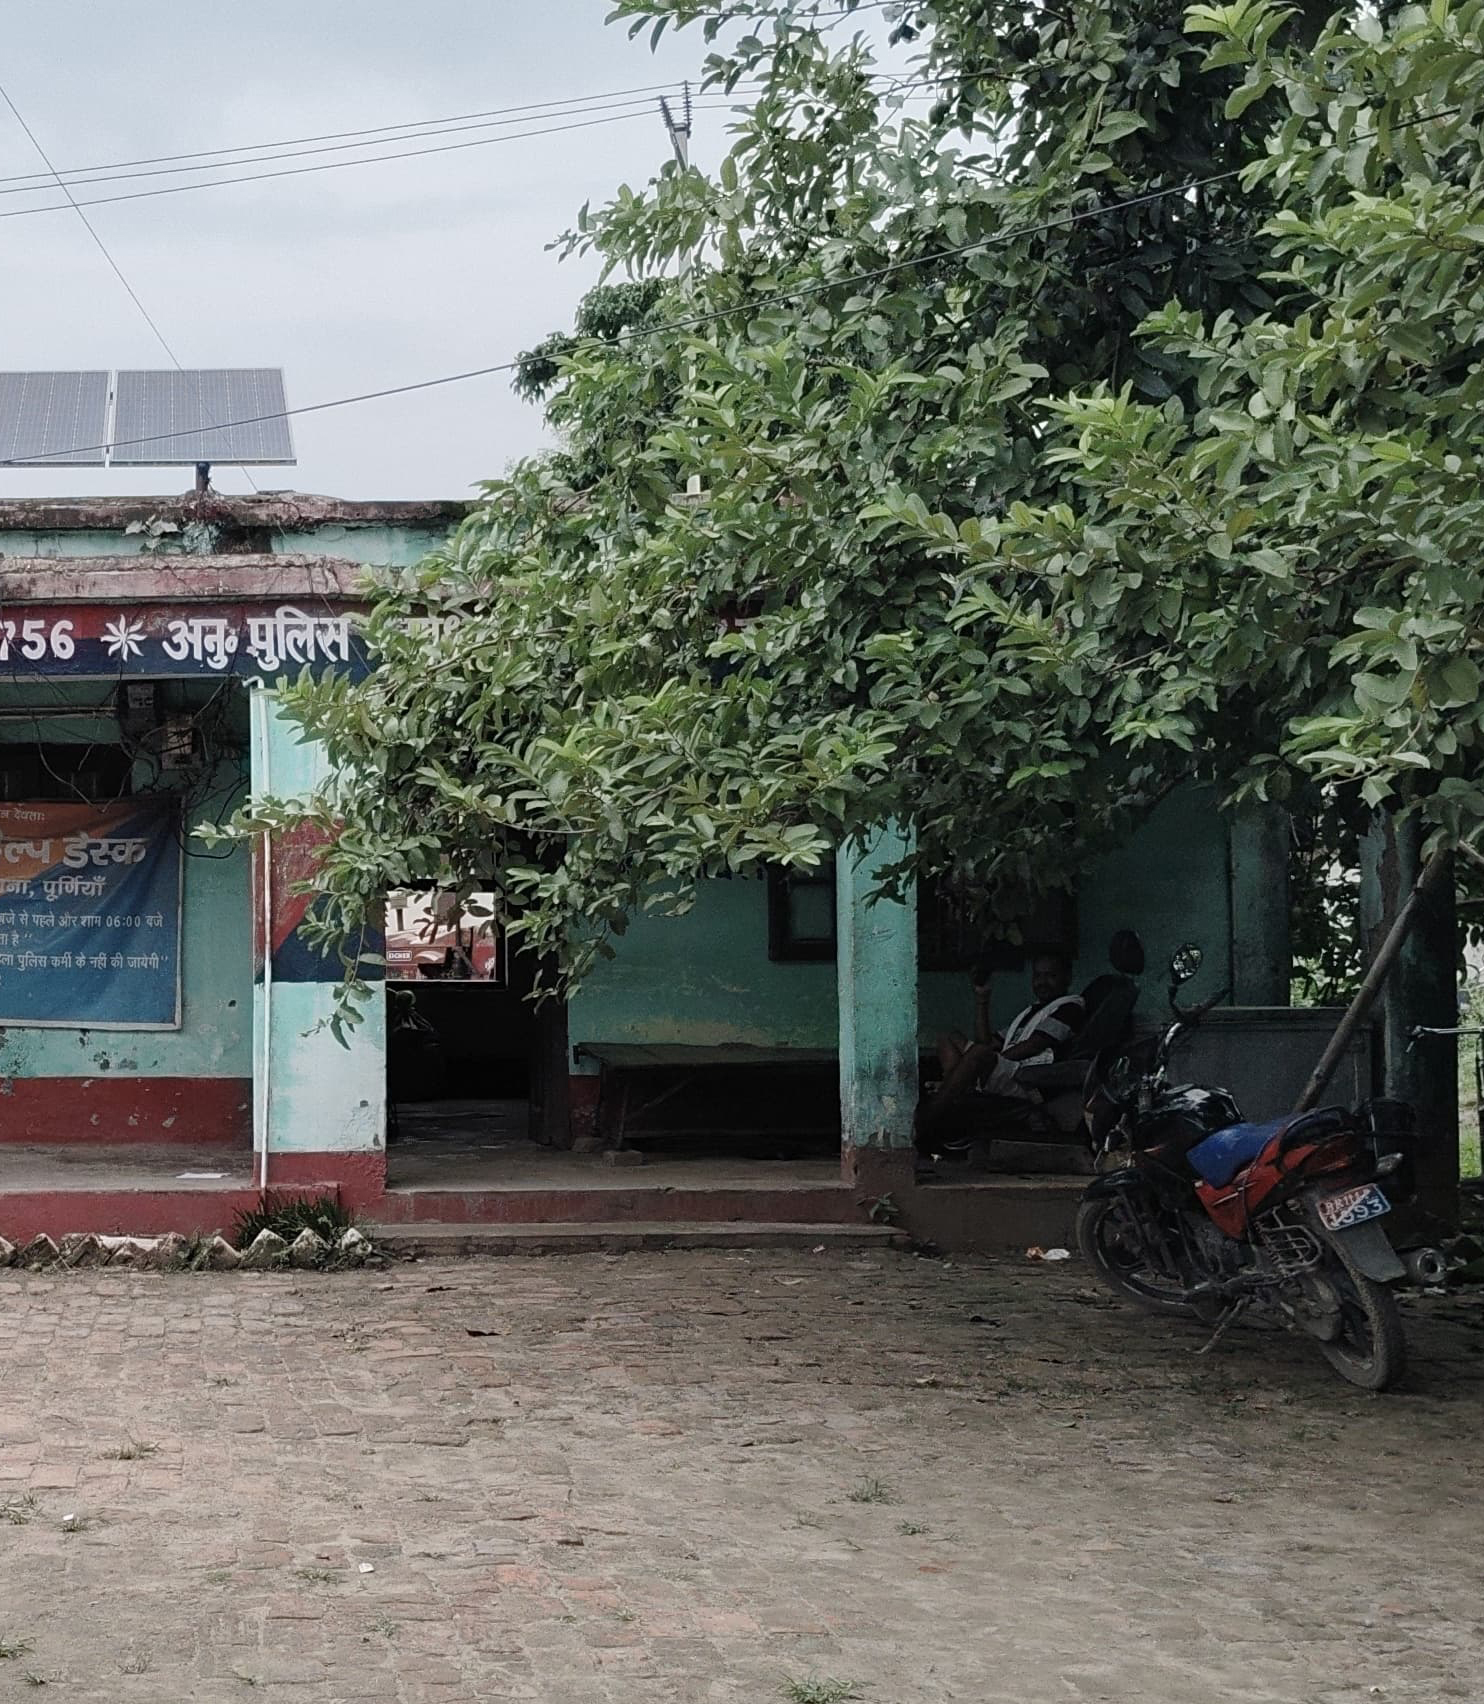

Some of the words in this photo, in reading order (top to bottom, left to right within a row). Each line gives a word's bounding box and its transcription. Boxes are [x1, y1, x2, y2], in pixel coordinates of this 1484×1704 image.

[246, 606, 352, 671] पुलिस
[62, 831, 150, 868] डेस्क
[18, 910, 29, 926] से
[32, 911, 55, 927] पहले
[80, 915, 101, 927] शाम
[106, 915, 141, 928] 06:00
[17, 951, 47, 972] पुलिस
[75, 952, 86, 968] के
